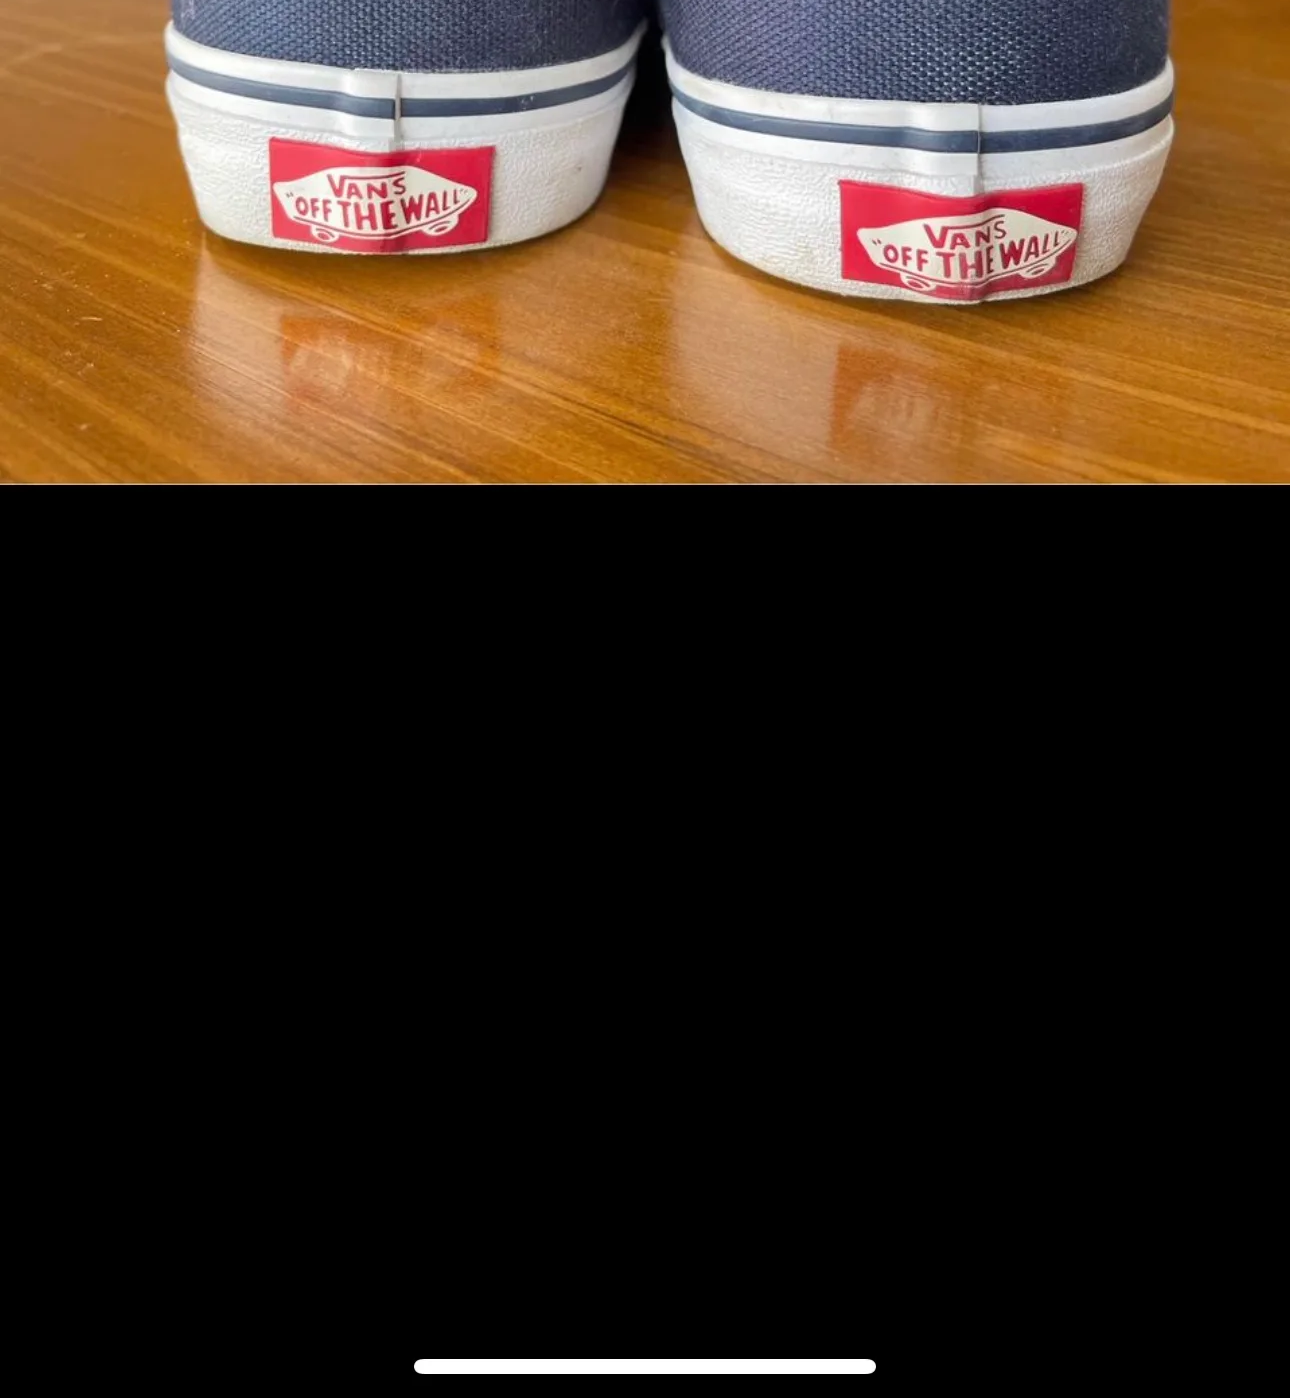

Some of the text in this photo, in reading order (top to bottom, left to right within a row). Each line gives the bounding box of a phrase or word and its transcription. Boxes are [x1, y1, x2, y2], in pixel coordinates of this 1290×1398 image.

[327, 171, 406, 200] VANS
[336, 199, 399, 231] THE
[923, 214, 1007, 250] VANS
[936, 246, 995, 280] THE
